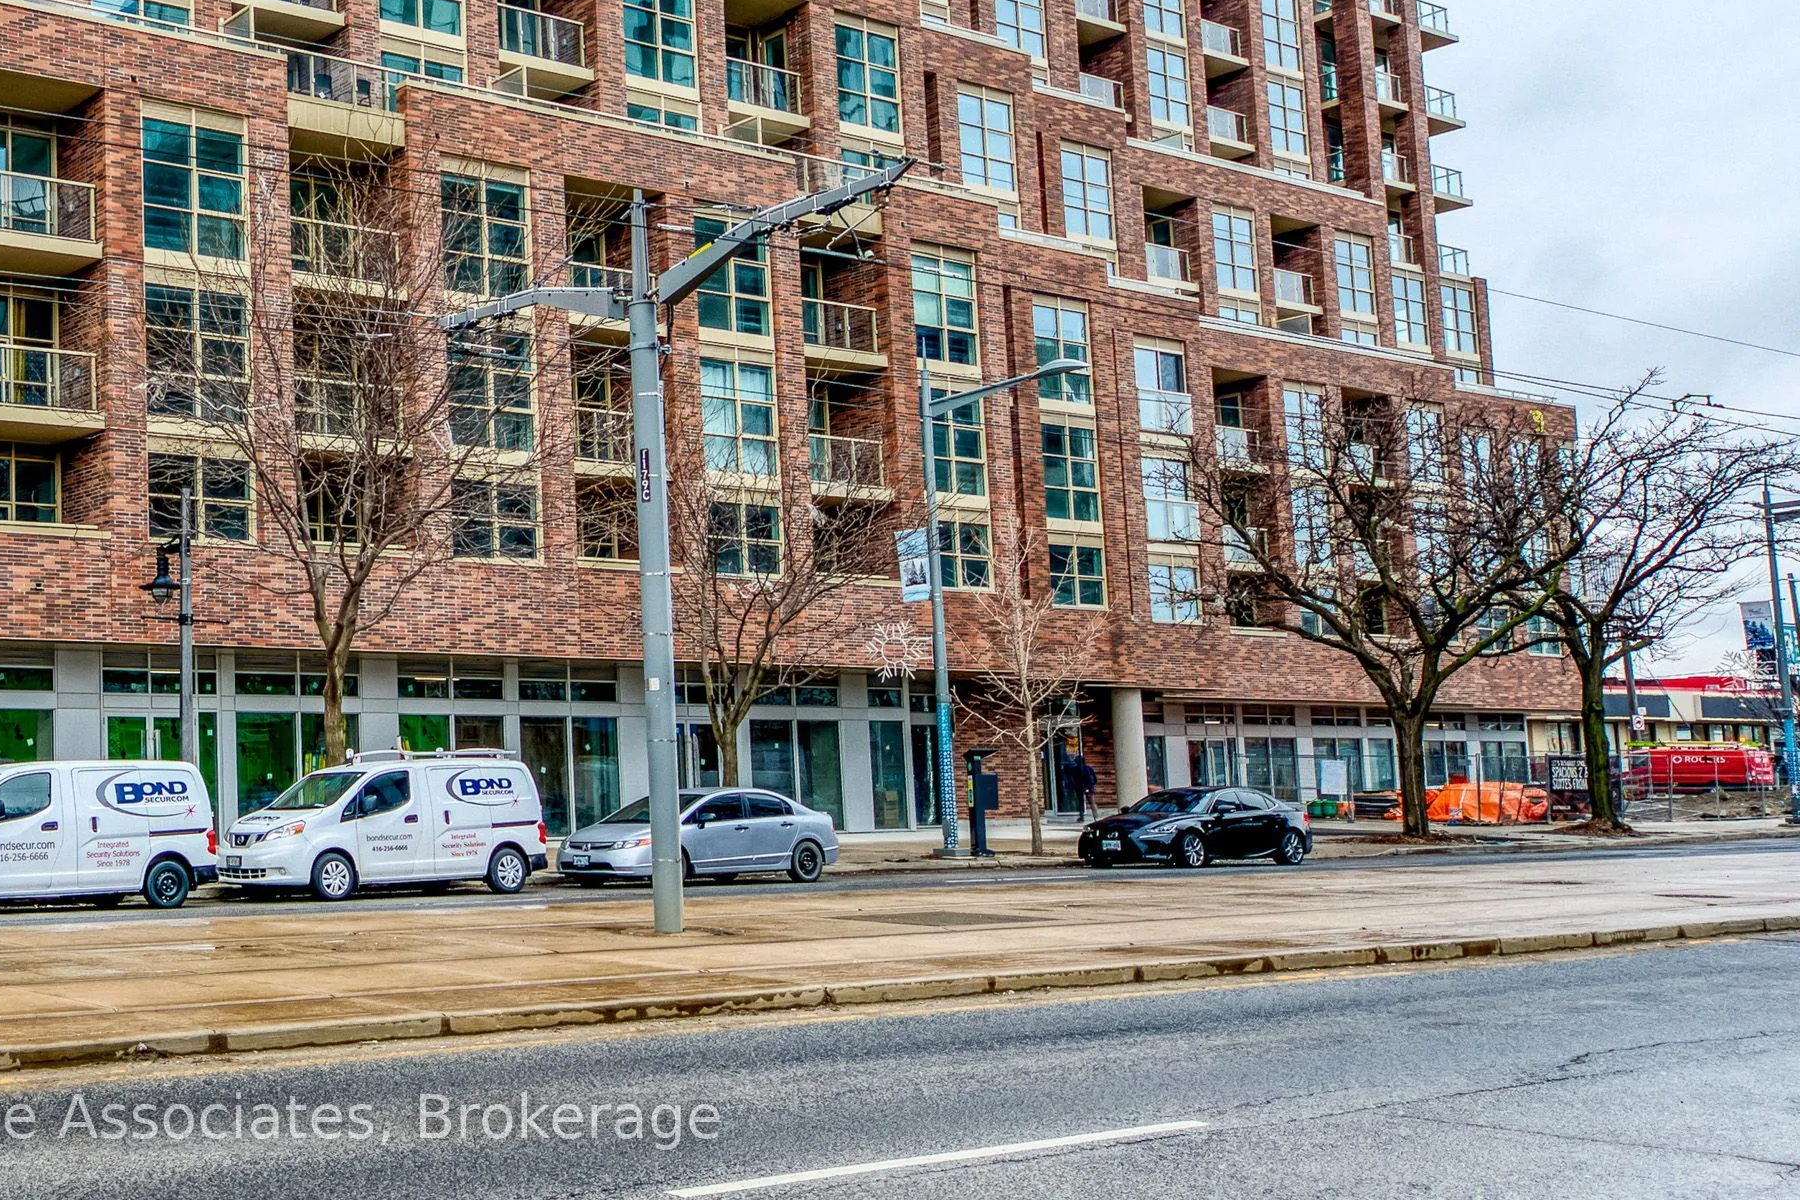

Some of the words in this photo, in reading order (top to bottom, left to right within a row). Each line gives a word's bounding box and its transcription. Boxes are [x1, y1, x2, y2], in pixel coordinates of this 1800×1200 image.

[459, 778, 512, 796] BOND
[114, 781, 188, 804] BOND
[144, 795, 190, 804] SECURCOM
[366, 833, 413, 842] bondsecur.com
[97, 841, 129, 849] Integrated
[86, 851, 111, 859] Security
[112, 850, 141, 858] Solutions
[96, 860, 114, 868] Since
[115, 859, 131, 867] 1978
